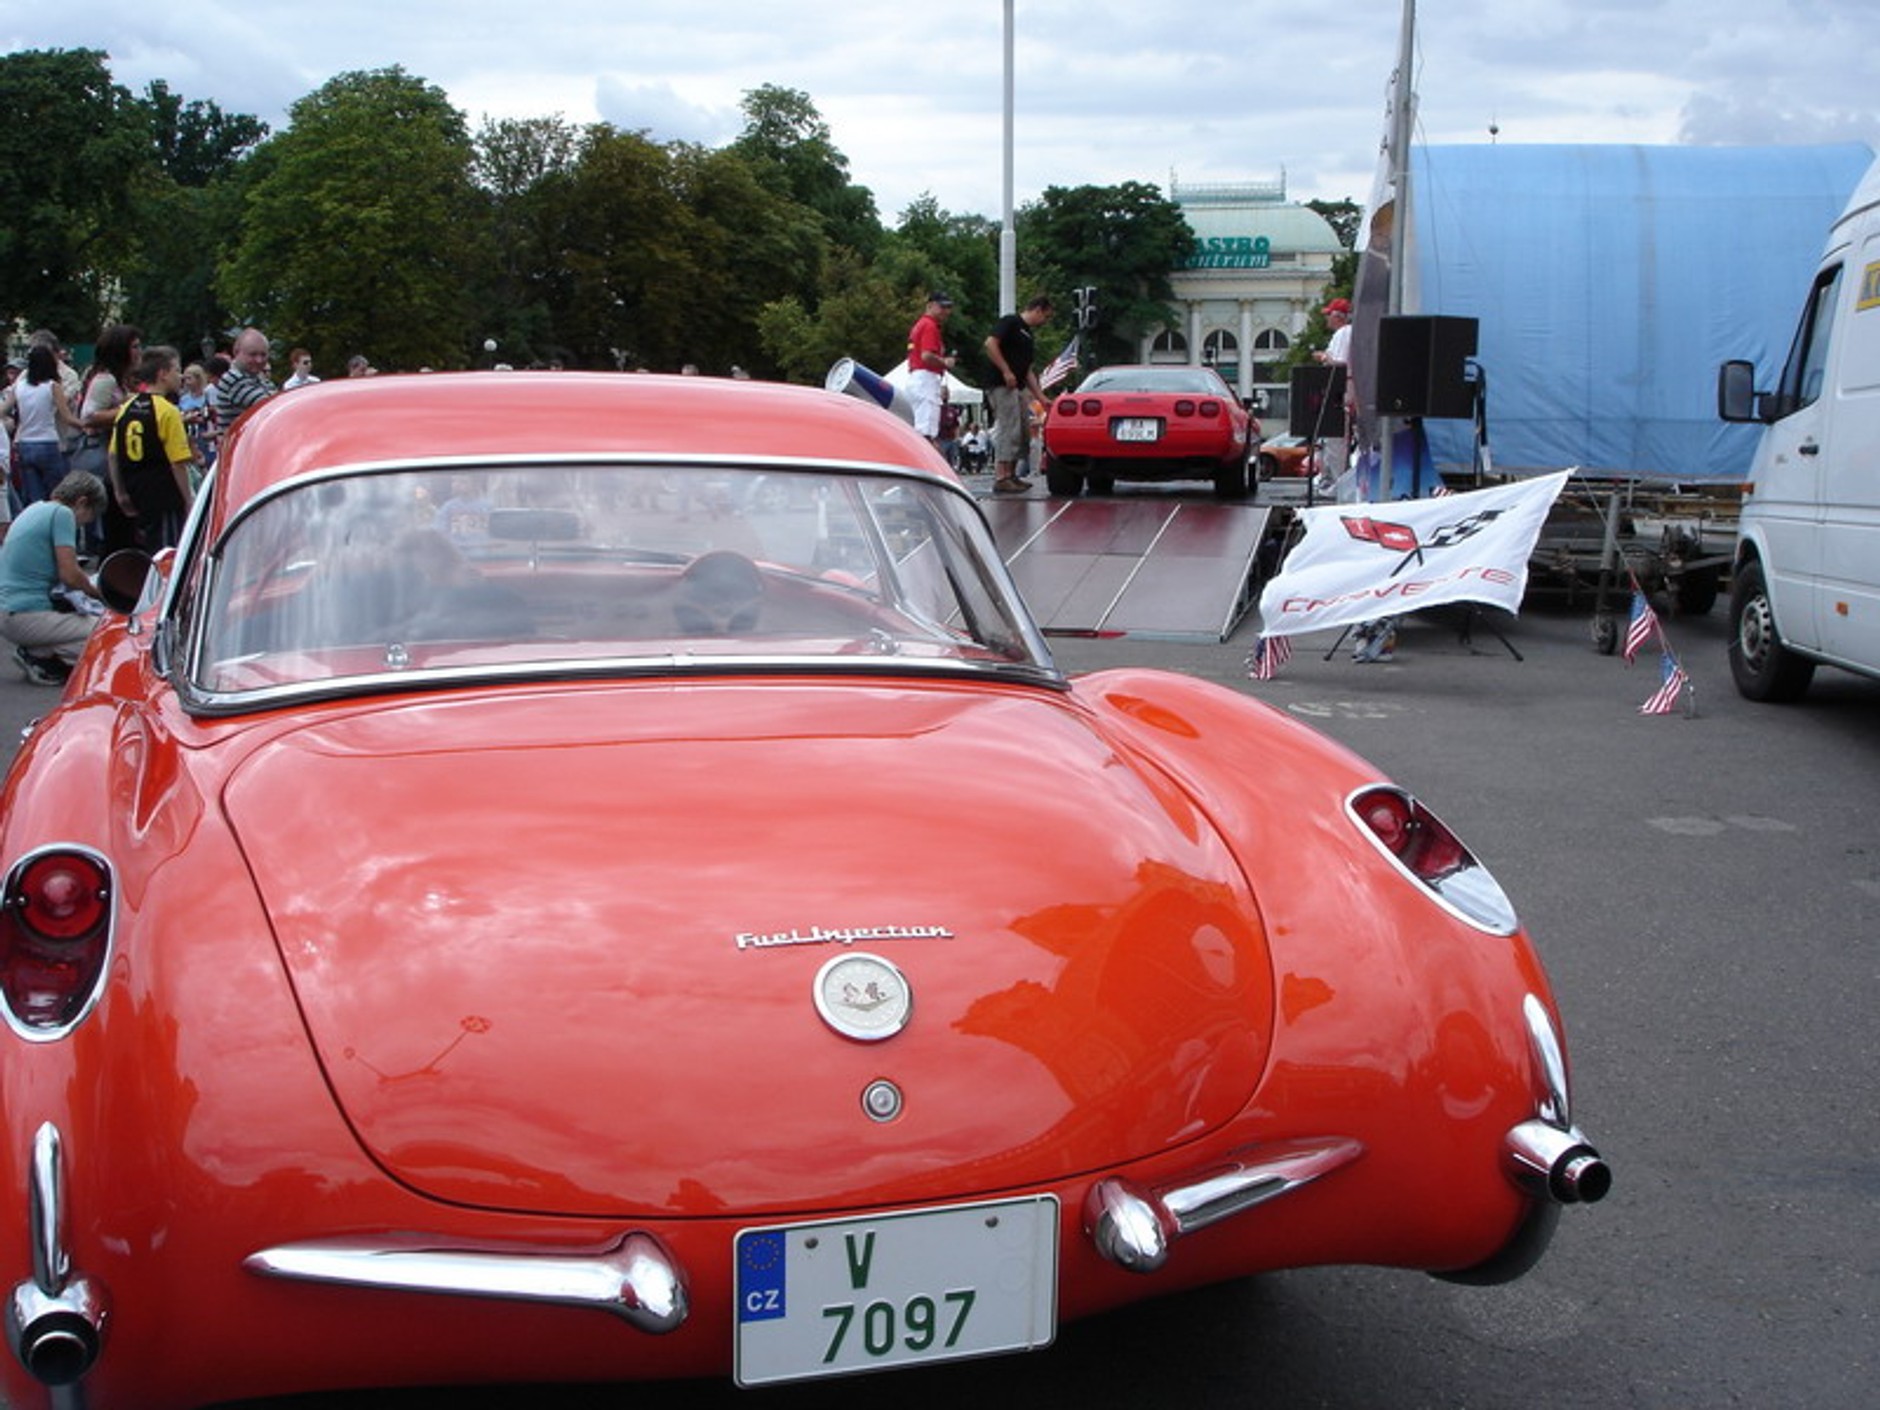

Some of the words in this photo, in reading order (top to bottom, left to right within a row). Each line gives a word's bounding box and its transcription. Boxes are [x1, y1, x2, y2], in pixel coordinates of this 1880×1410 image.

[1188, 236, 1270, 255] ASTRO
[126, 420, 144, 462] 6
[1280, 565, 1517, 614] CVETE
[735, 929, 812, 950] Fuel
[810, 925, 954, 947] Injection
[844, 1231, 876, 1290] V
[746, 1289, 780, 1312] CZ
[822, 1289, 976, 1365] 7097
